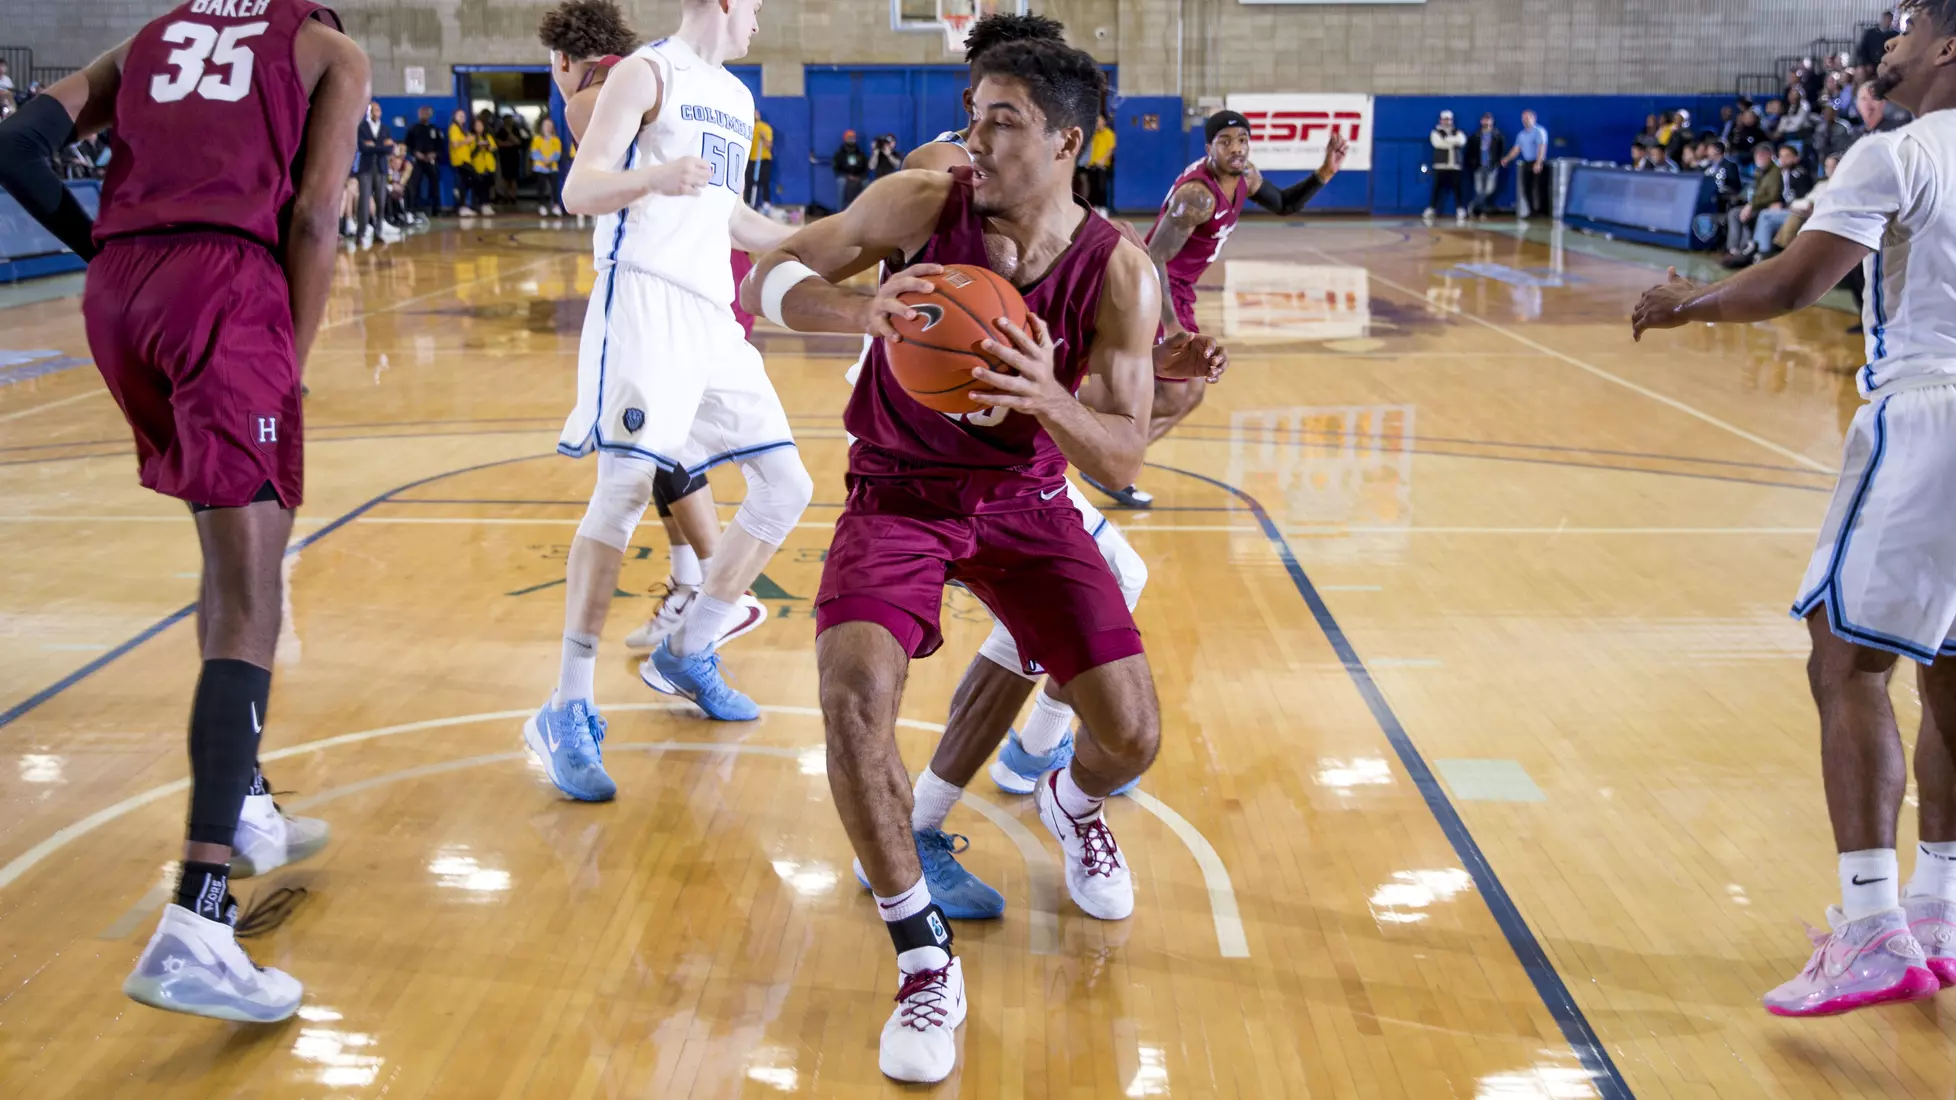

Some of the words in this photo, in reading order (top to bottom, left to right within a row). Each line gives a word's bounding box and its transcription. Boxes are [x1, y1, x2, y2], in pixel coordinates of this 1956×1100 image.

[191, 0, 271, 17] BAKER
[150, 20, 270, 103] 35
[1242, 112, 1361, 141] ESPN
[701, 131, 745, 195] 50
[258, 417, 277, 442] H
